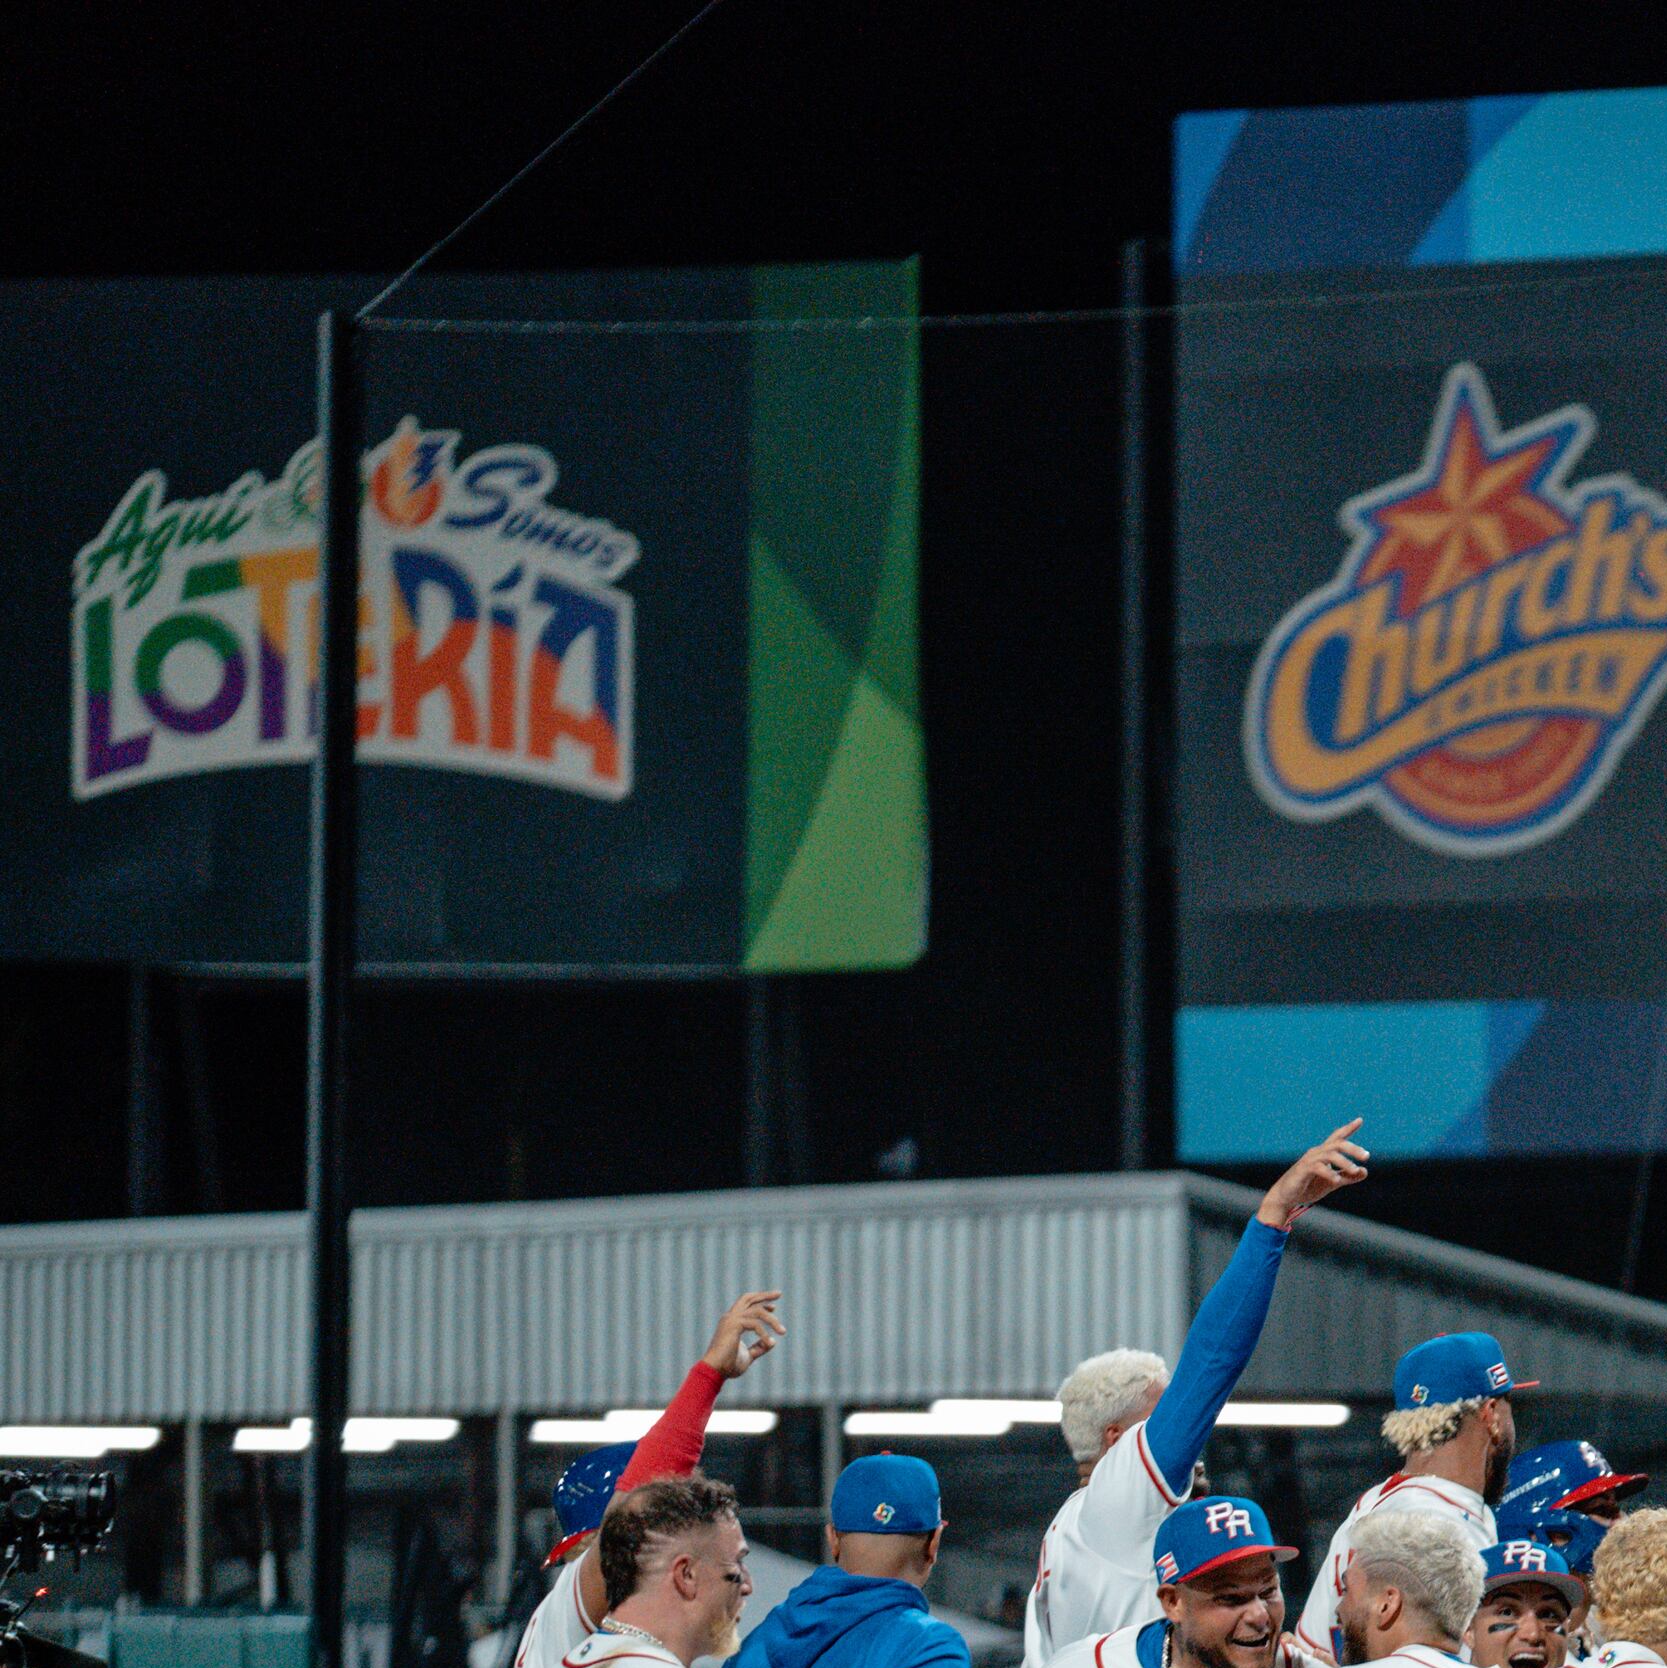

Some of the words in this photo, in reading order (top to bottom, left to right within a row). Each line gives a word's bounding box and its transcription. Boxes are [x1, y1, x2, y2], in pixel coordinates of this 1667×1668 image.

[446, 458, 622, 568] Somos
[1205, 1501, 1255, 1539] PR
[1503, 1539, 1548, 1573] PR
